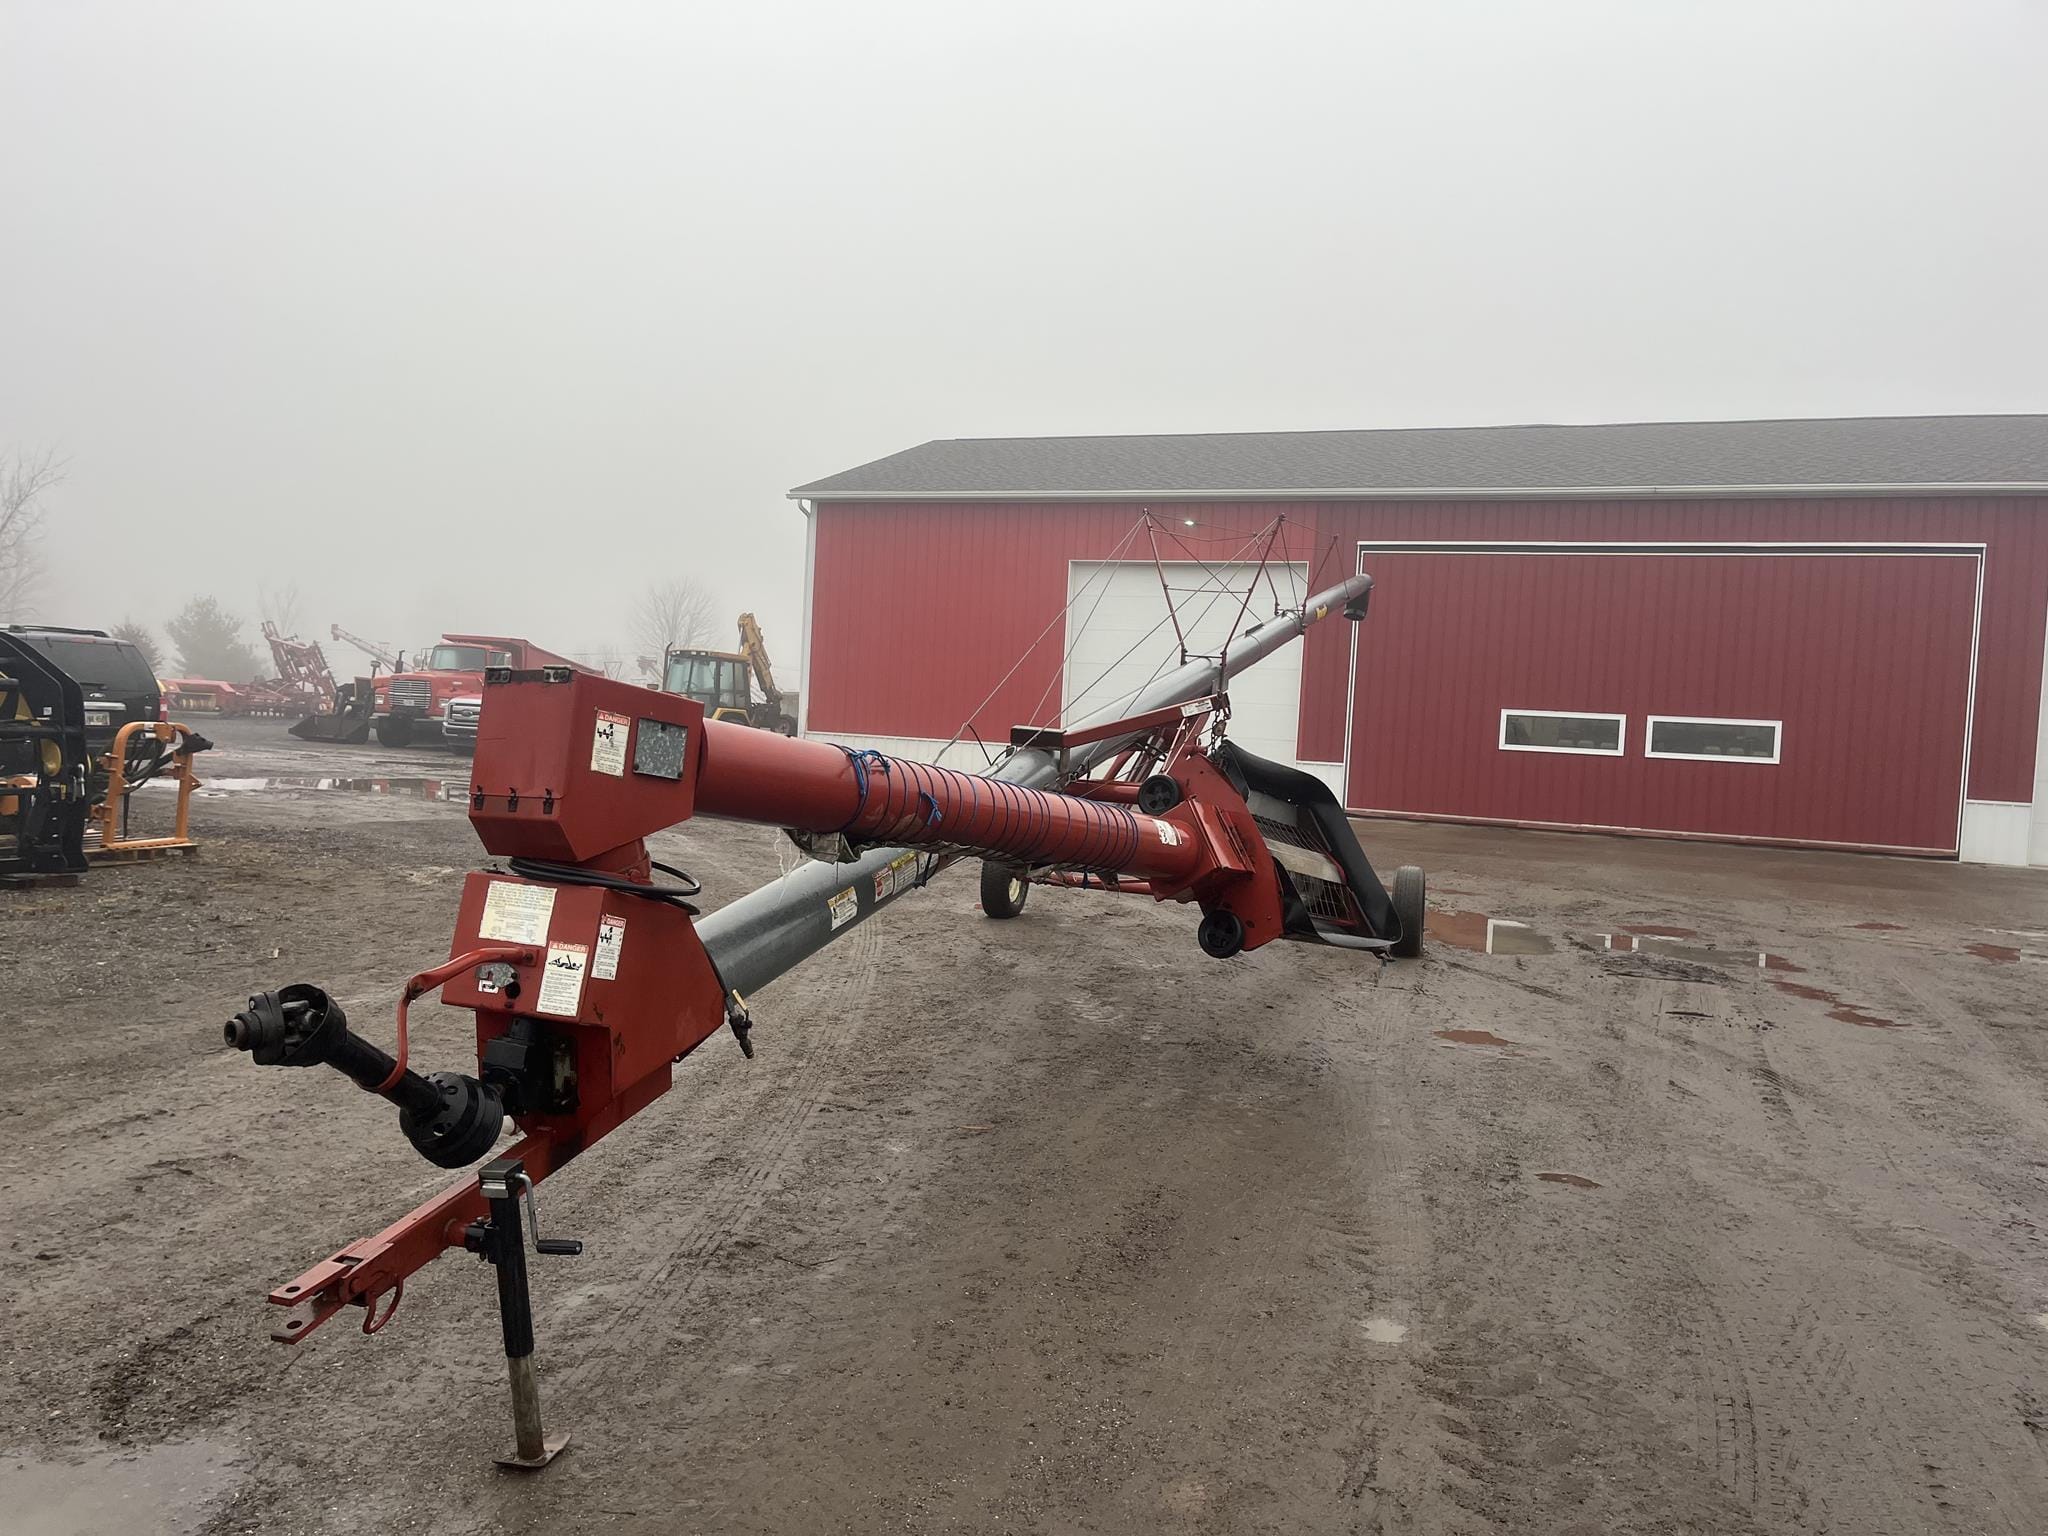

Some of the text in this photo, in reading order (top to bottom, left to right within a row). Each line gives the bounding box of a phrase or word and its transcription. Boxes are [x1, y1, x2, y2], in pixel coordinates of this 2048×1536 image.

[604, 714, 628, 725] DANGER
[606, 918, 624, 927] DANGER
[558, 943, 586, 952] DANGER
